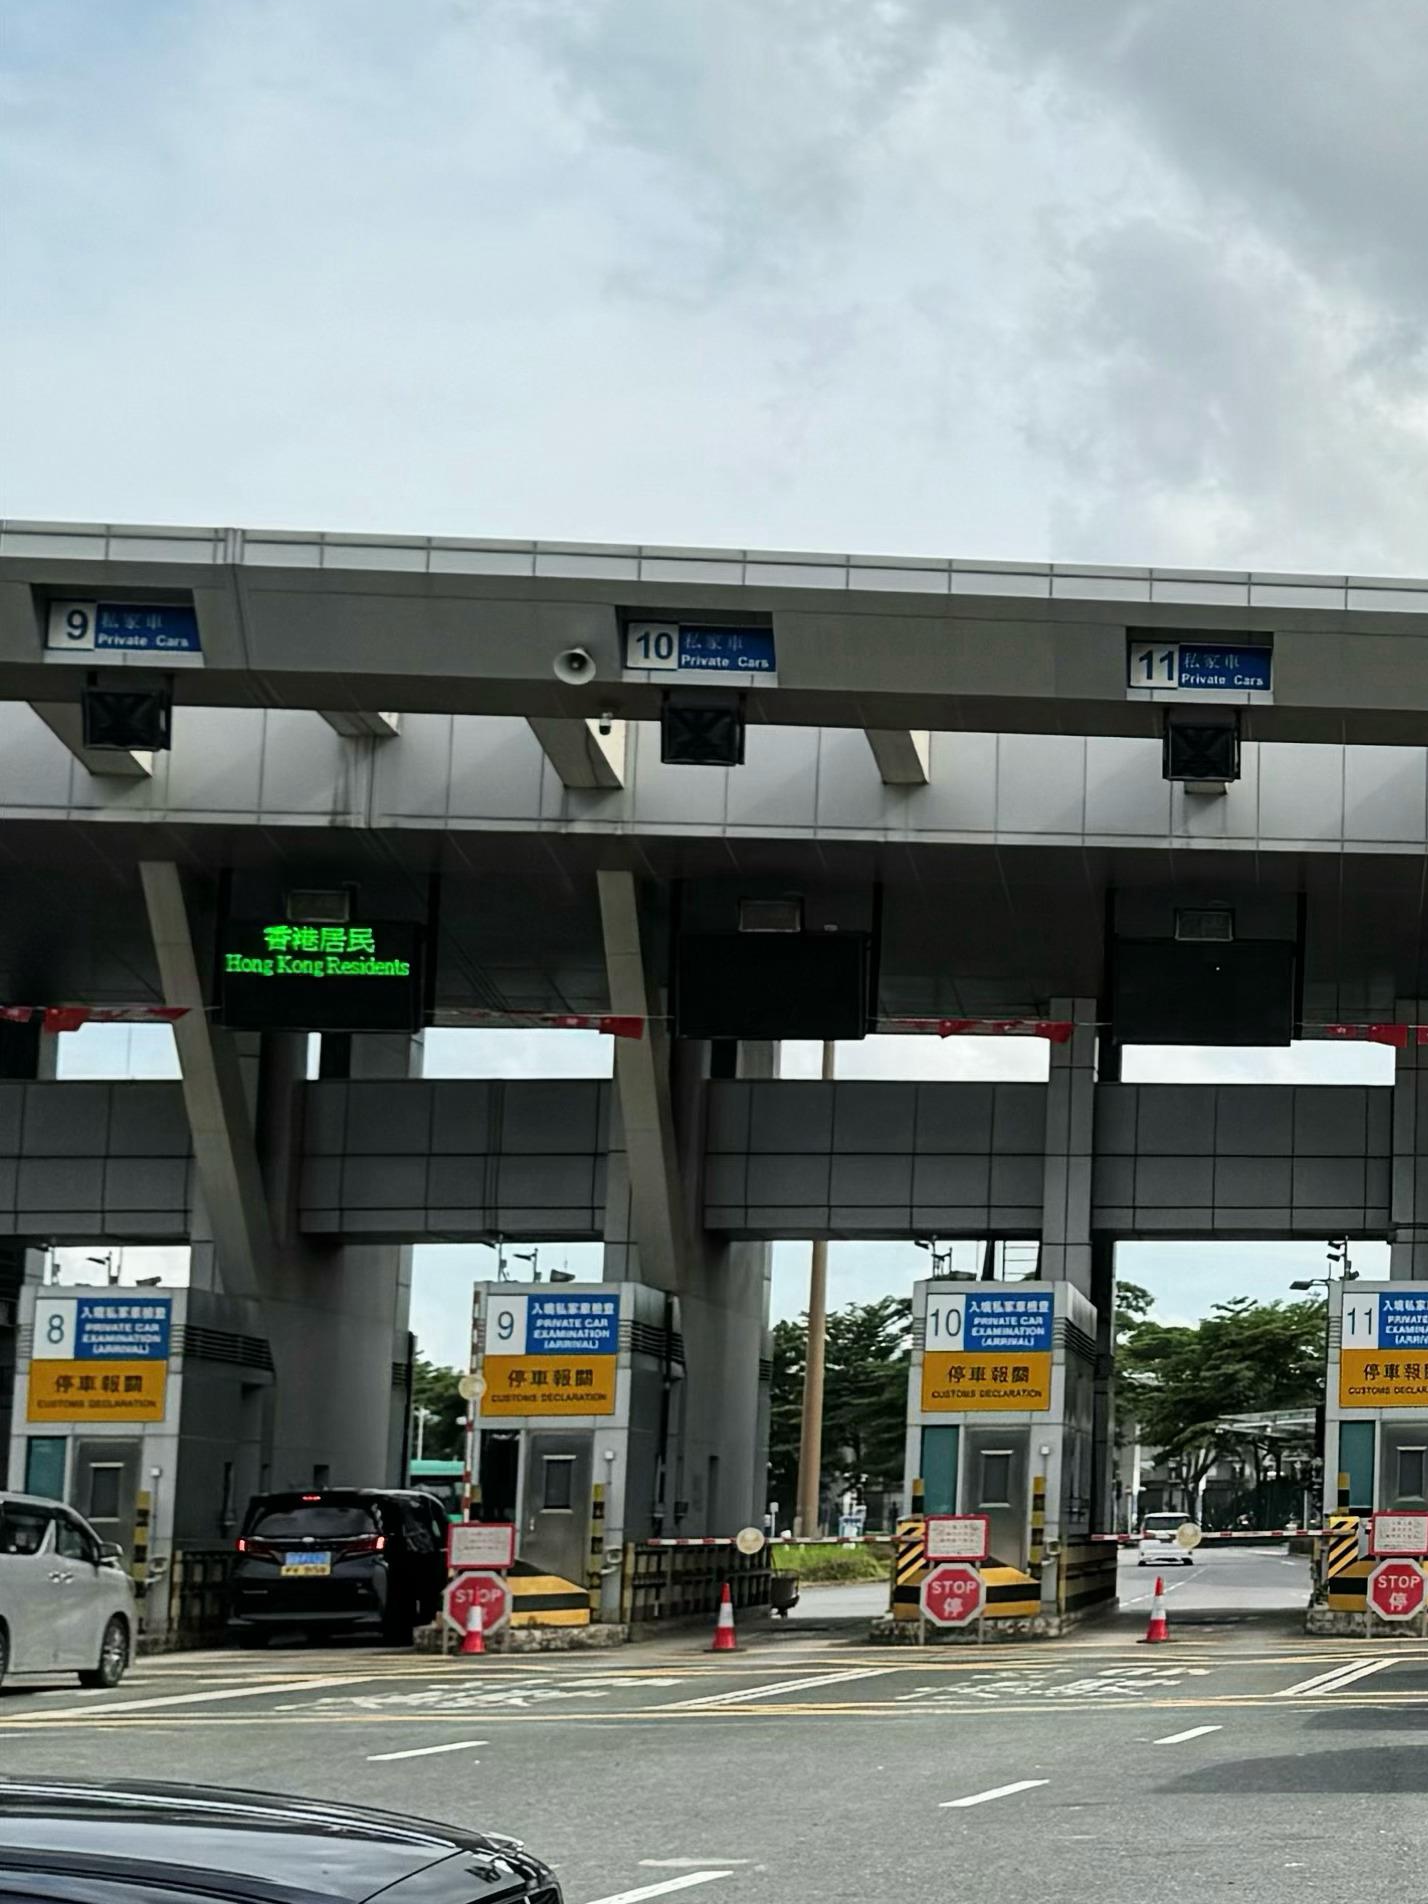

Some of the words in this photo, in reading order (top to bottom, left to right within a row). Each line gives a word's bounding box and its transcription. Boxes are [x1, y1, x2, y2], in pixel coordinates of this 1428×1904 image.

[66, 609, 88, 640] 9
[98, 634, 147, 648] Private
[156, 636, 189, 648] Cars
[635, 632, 674, 660] 10
[680, 655, 730, 667] Private
[738, 656, 768, 668] Cars
[1139, 649, 1175, 681] 11
[1181, 673, 1226, 685] Private
[1233, 674, 1264, 686] Cars
[263, 926, 374, 953] 香港居民
[225, 954, 273, 976] Hong
[277, 955, 323, 978] Kong
[326, 956, 410, 977] Residents
[497, 1311, 515, 1340] 9
[536, 1318, 582, 1328] PRIVATE
[584, 1319, 608, 1328] CAR
[930, 1308, 962, 1336] 10
[973, 1316, 1018, 1326] PRIVATE
[1020, 1317, 1043, 1326] CAR
[1347, 1307, 1373, 1335] 11
[1387, 1315, 1428, 1324] PRIVATE
[47, 1314, 65, 1344] 8
[85, 1323, 131, 1332] PRIVATE
[134, 1323, 159, 1333] CAR
[533, 1329, 609, 1338] EXAMINATION
[971, 1326, 1045, 1336] EXAMINATION
[82, 1334, 160, 1343] EXAMINATION
[543, 1339, 599, 1349] (ARRIVAL)
[981, 1336, 1034, 1346] (ARRIVAL)
[92, 1344, 149, 1354] (ARRIVAL)
[508, 1369, 593, 1387] 停車報關
[949, 1366, 1029, 1383] 停車報關
[55, 1374, 143, 1393] 停車報關
[931, 1390, 976, 1399] CUSTOMS
[980, 1389, 1042, 1398] DECLARATION
[1348, 1386, 1391, 1395] CUSTOMS
[37, 1398, 85, 1408] CUSTOMS
[88, 1398, 156, 1408] DECLARATION
[491, 1393, 537, 1403] CUSTOMS
[540, 1393, 606, 1402] DECLARATION
[931, 1580, 977, 1594] STOP
[1378, 1575, 1420, 1589] STOP
[454, 1589, 502, 1603] STOP
